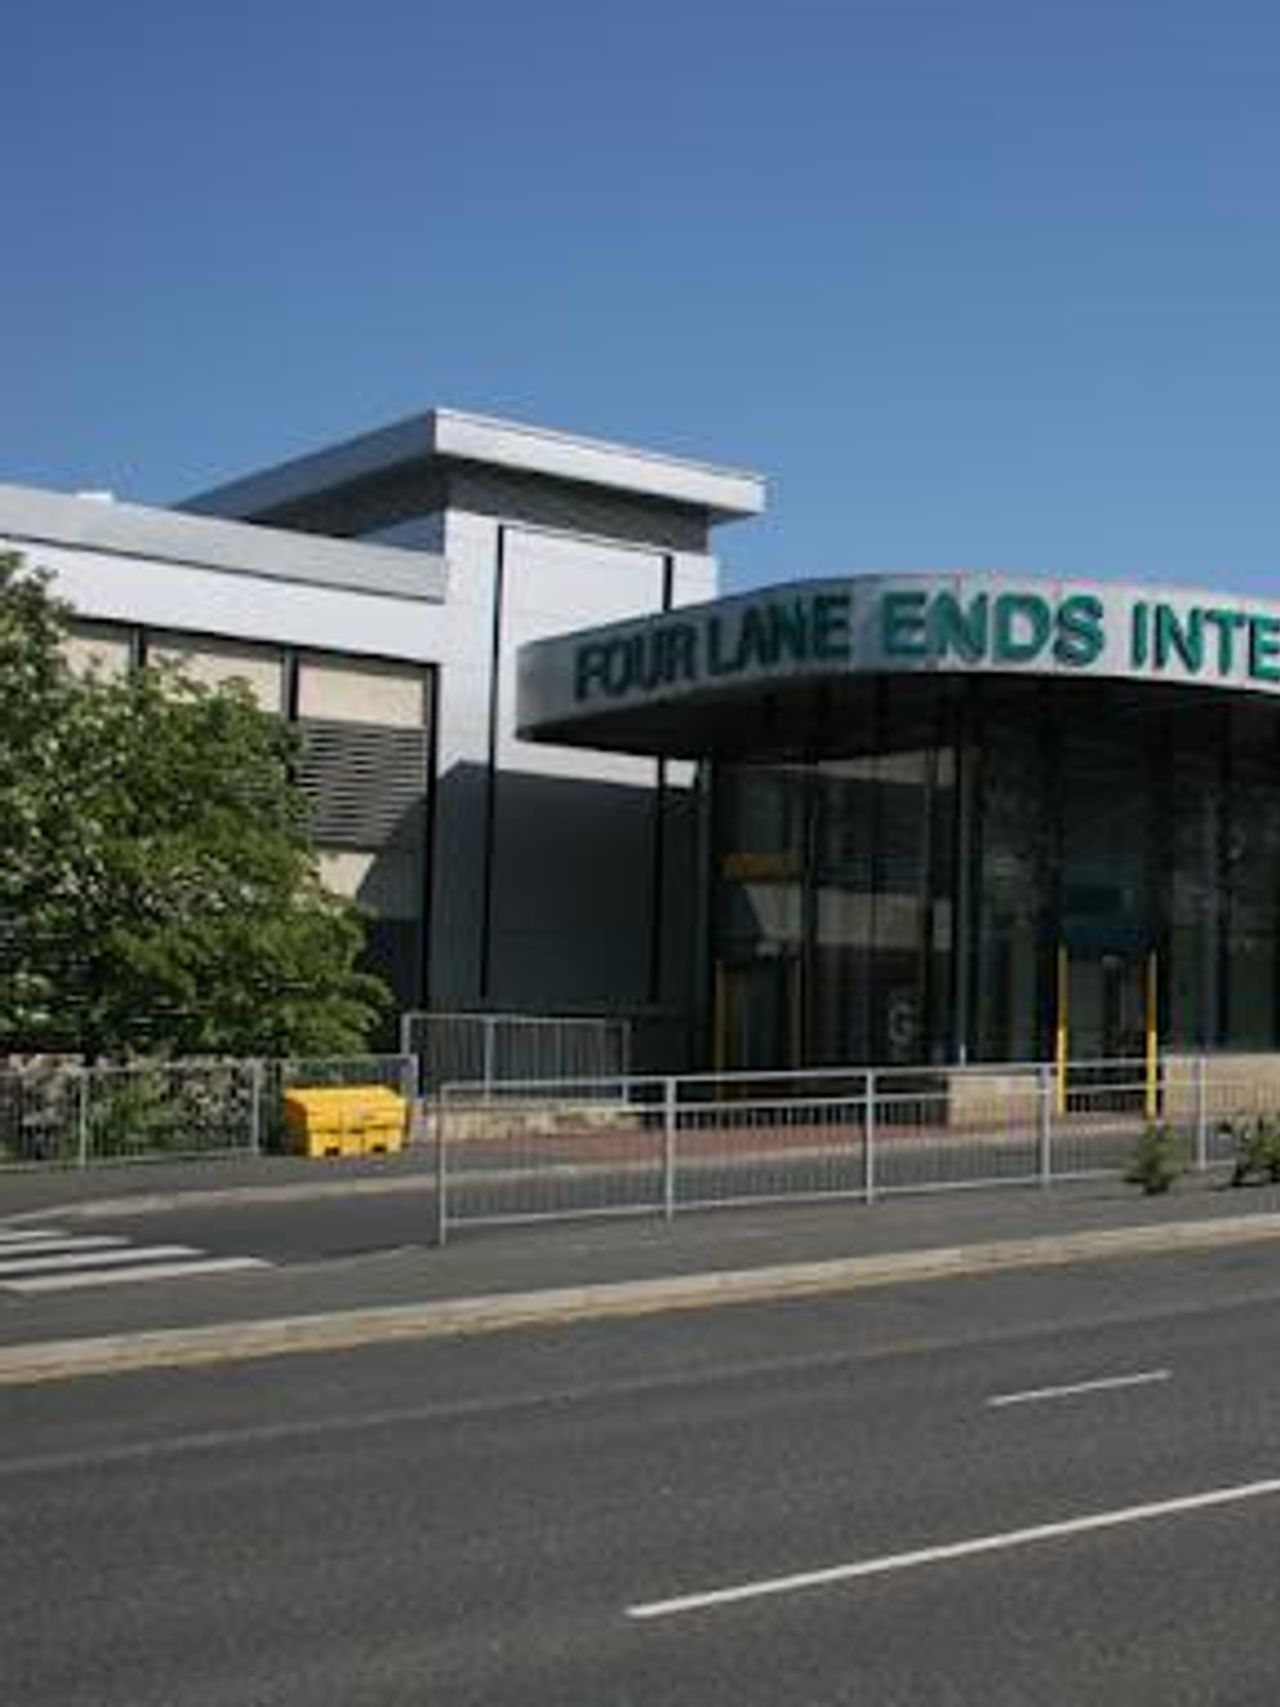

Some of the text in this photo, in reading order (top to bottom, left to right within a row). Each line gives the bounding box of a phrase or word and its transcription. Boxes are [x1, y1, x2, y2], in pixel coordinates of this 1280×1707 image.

[575, 622, 696, 700] FOUR
[707, 594, 852, 675] LANE
[881, 588, 1105, 669] ENDS
